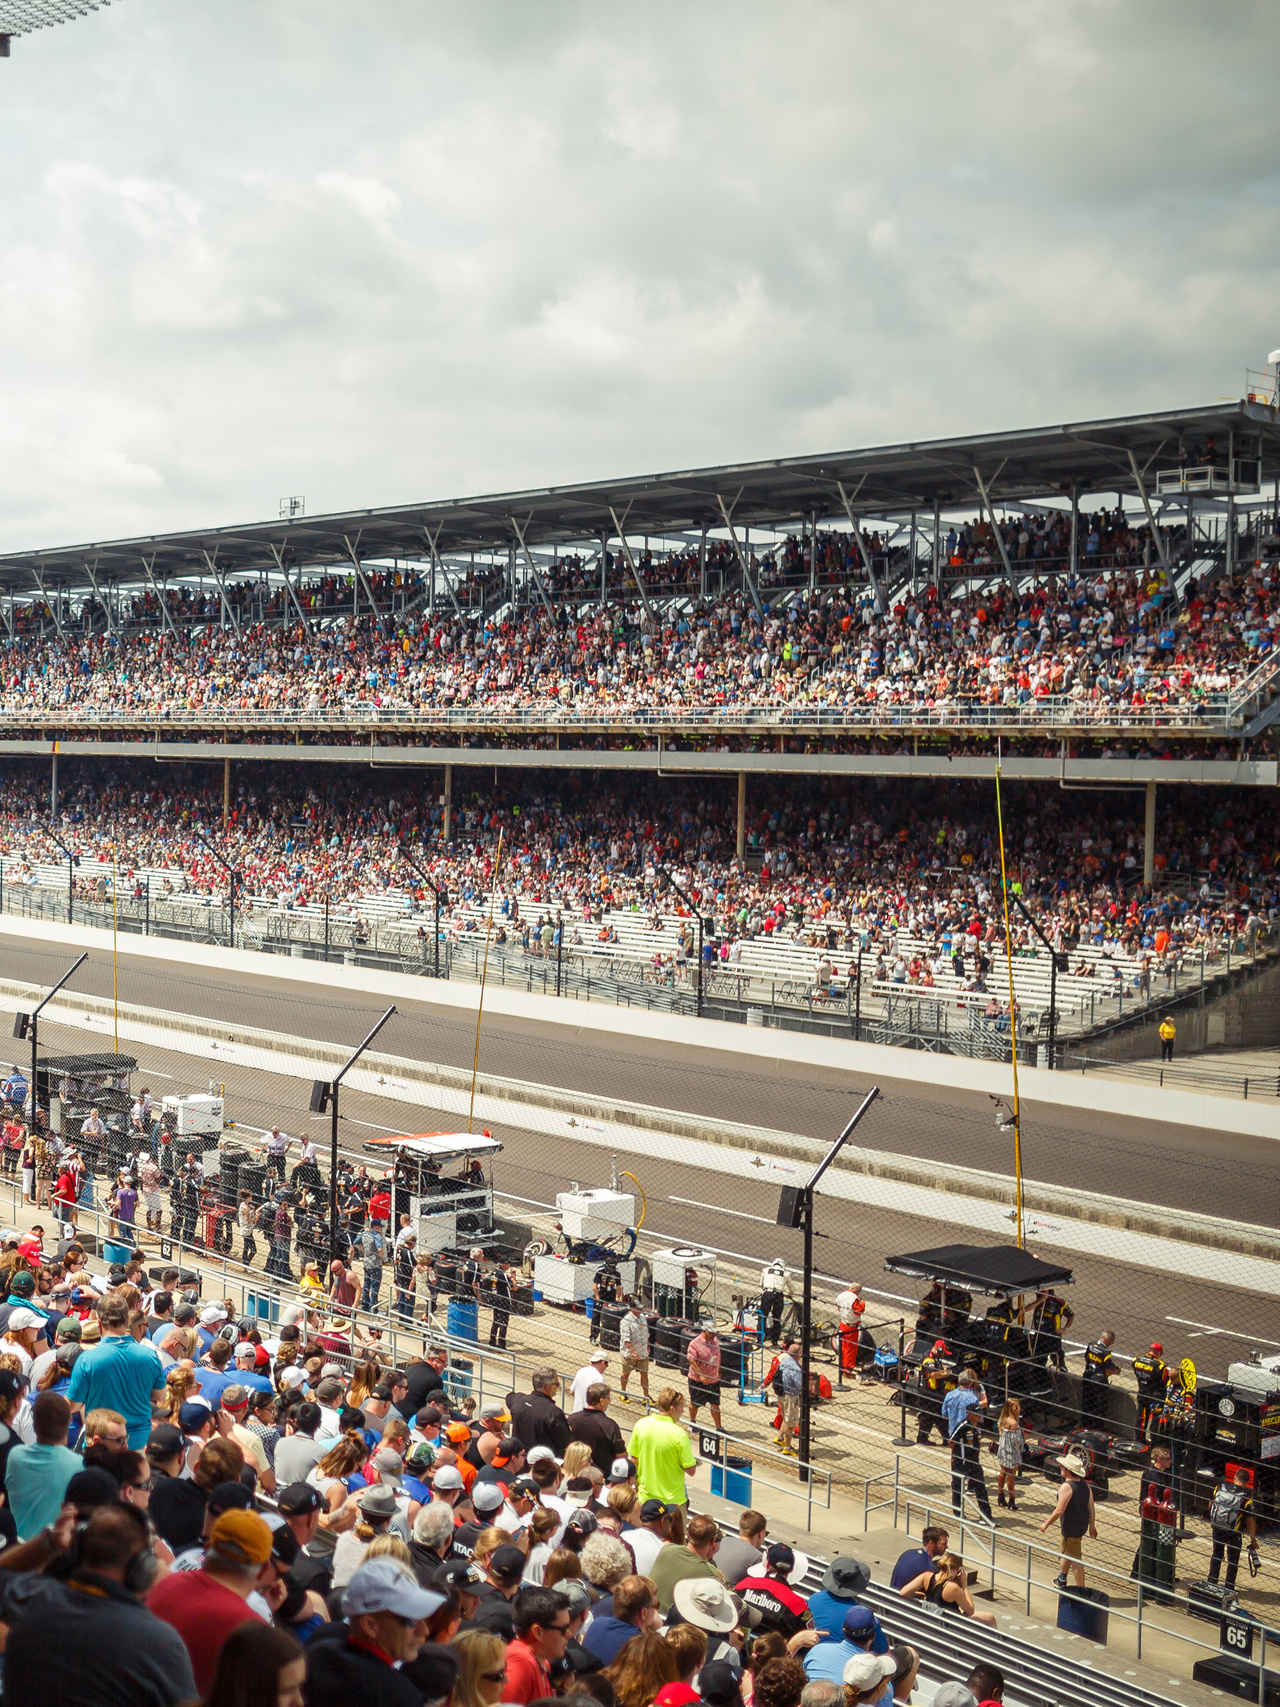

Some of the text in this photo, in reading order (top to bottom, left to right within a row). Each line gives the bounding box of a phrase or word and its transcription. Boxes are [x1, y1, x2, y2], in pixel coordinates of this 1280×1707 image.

[162, 1244, 171, 1256] 62
[702, 1437, 717, 1456] 64
[743, 1588, 782, 1613] Marlboro
[1226, 1626, 1247, 1649] 65
